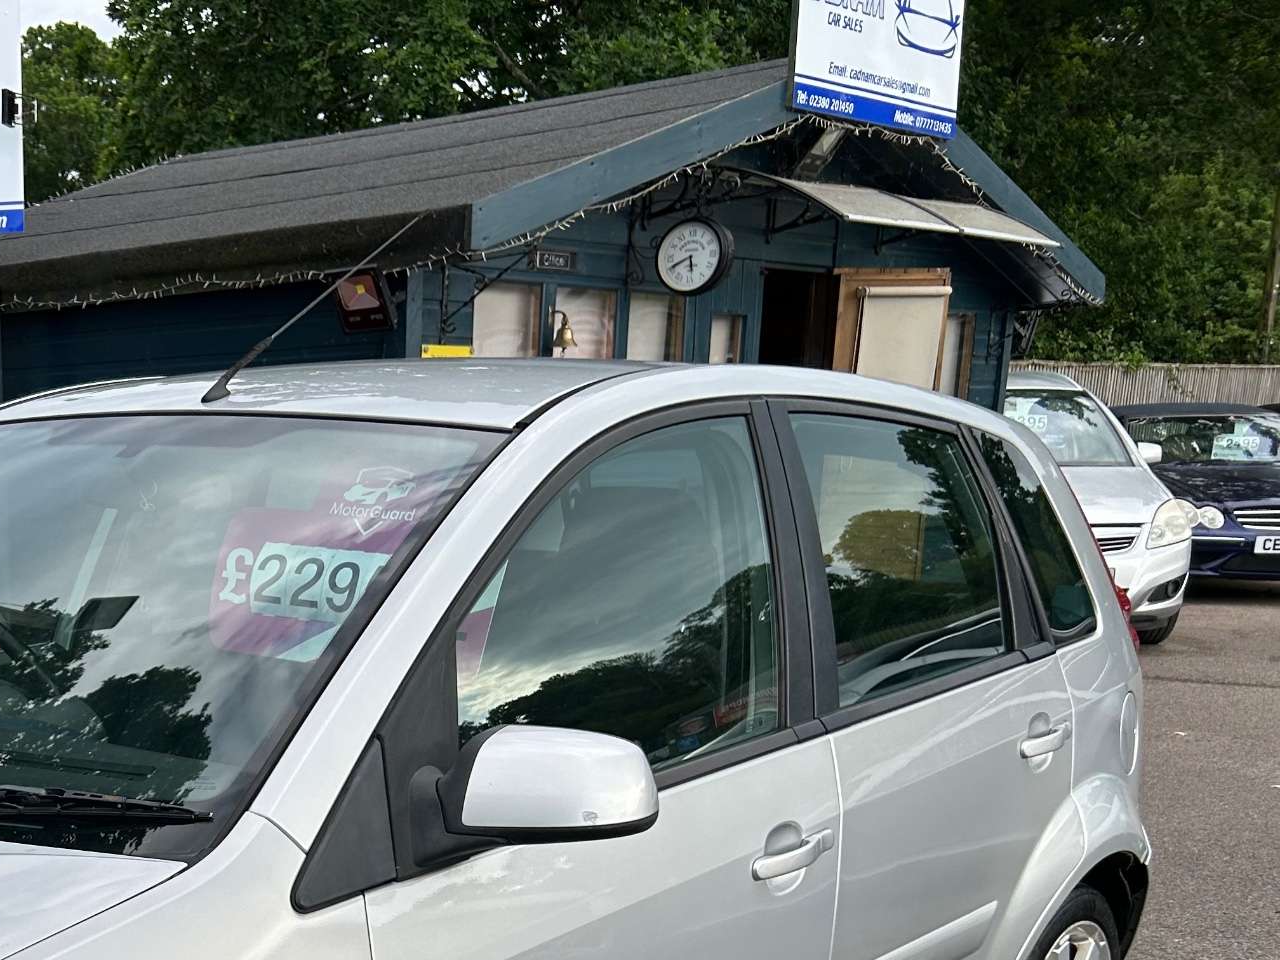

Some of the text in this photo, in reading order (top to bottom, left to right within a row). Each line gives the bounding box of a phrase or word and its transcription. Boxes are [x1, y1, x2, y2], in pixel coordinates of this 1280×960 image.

[827, 11, 863, 33] CAR SALES
[828, 61, 849, 77] Email:
[796, 90, 854, 114] Tel: 02380 201450
[893, 109, 915, 126] Mobile:
[329, 502, 417, 522] MotorGuard
[219, 547, 365, 614] £229
